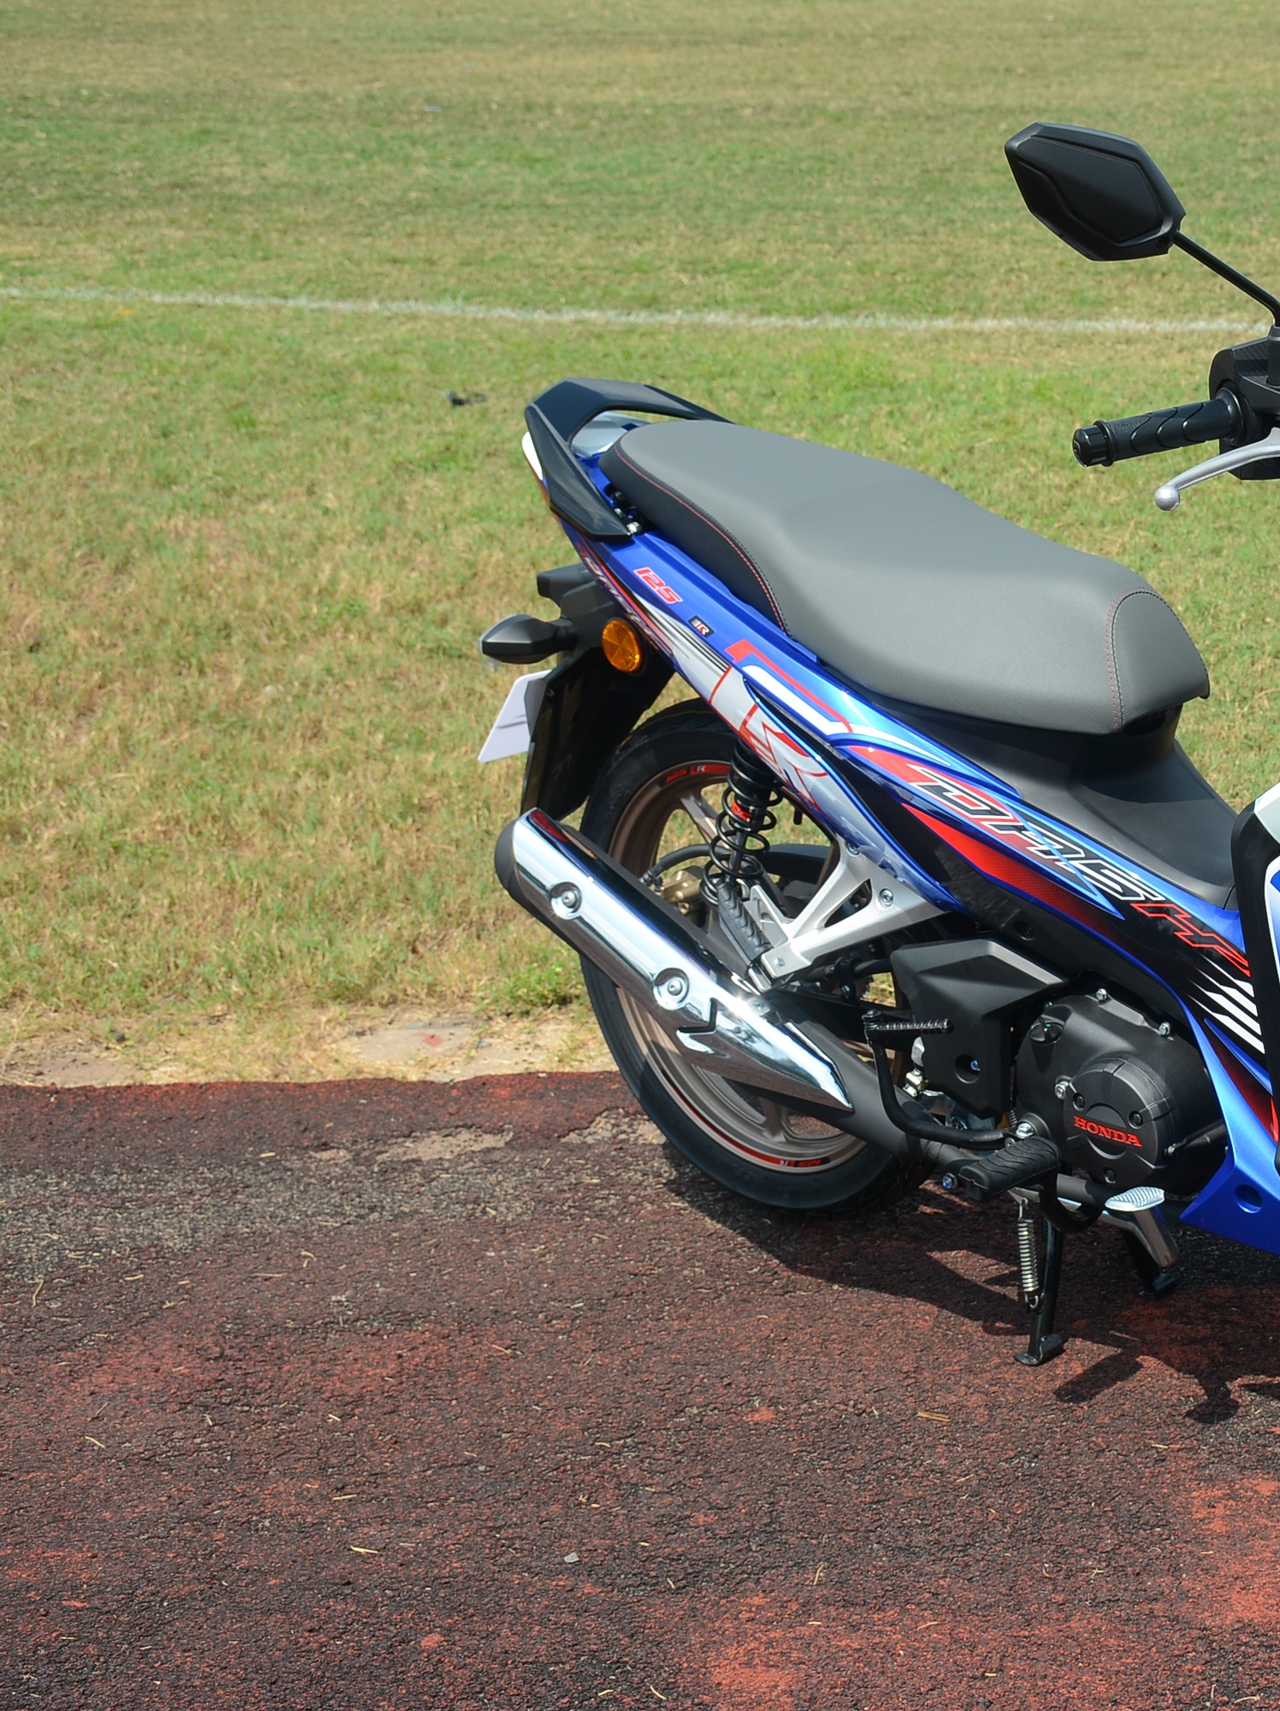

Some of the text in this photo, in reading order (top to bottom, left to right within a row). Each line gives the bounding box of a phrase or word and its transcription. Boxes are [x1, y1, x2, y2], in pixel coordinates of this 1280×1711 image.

[633, 567, 683, 604] 125
[905, 763, 1251, 978] DASH
[1073, 1115, 1143, 1148] HONDA
